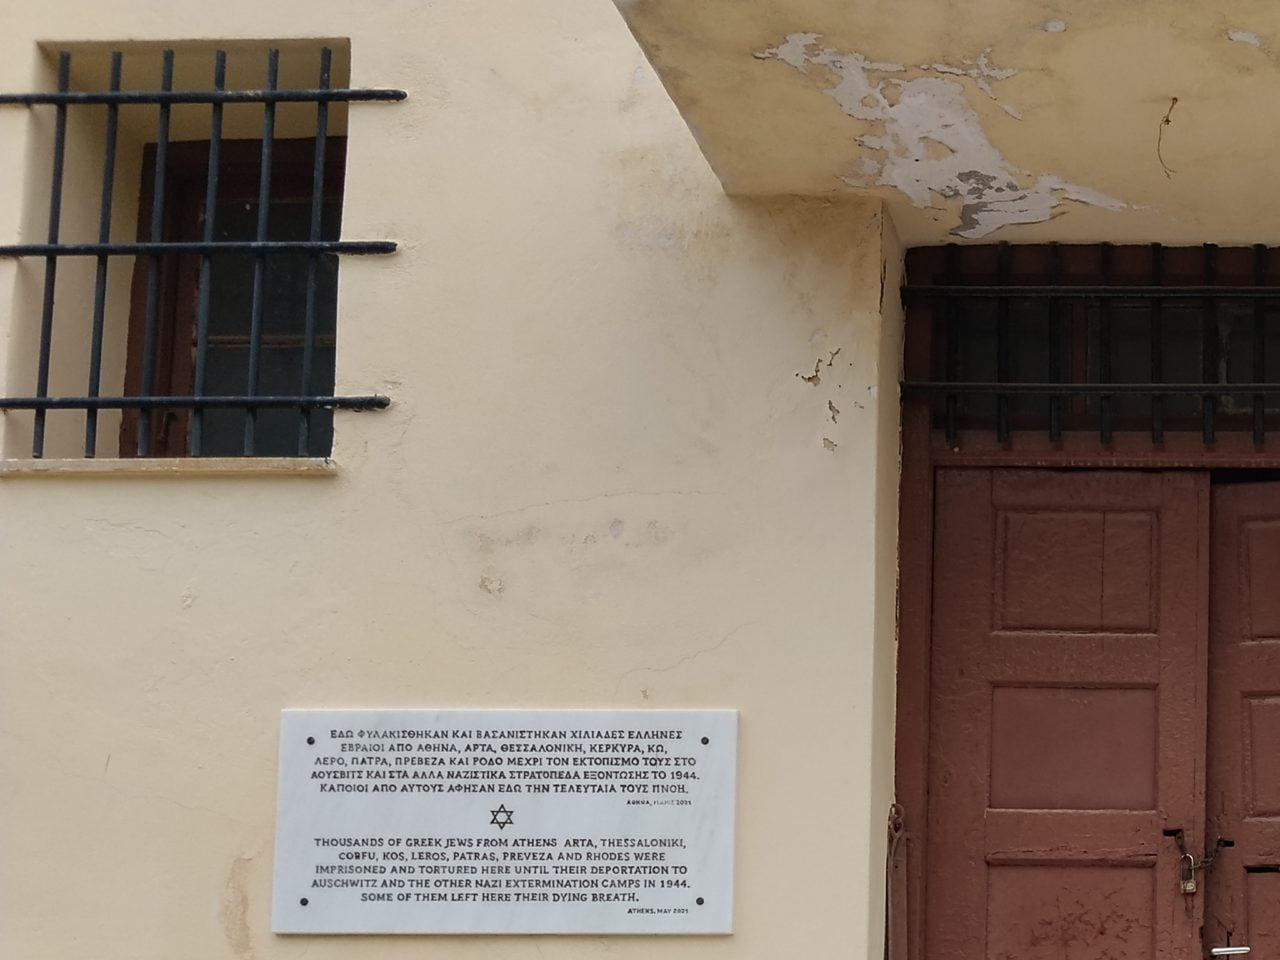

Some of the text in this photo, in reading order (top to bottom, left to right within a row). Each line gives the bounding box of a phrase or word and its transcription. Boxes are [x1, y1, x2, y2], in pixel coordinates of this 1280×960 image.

[330, 730, 683, 739] ΕΔΩ ΦΥΛΑΚΙΣΘΗΚΑΝ ΚΑΙ ΒΑΣΑΝΙΣΤΗΚΑΝ ΧΙΛΙΑΔΕΣ ΕΛΛΗΝΕΣ
[340, 743, 385, 752] ΕΒΡΑΙΟΙ
[416, 744, 461, 753] ΑΘΗΝΑ,
[464, 744, 497, 753] ΑΡΤΑ,
[501, 744, 586, 754] ΘΕΣΣΑΛΟΝΙΚΗ,
[589, 744, 645, 754] ΚΕΡΚΥΡΑ,
[647, 744, 668, 754] ΚΩ,
[314, 757, 697, 767] ΛΕΡΟ, ΠΑΤΡΑ, ΠΡΕΒΕΖΑ ΚΑΙ ΡΟΔΟ ΜΕΧΡΙ ΤΟΝ ΕΚΤΟΠΙΣΜΟ ΤΟΥΣ ΣΤΟ
[310, 770, 701, 780] ΑΟΥΣΒΙΤΣ ΚΑΙ ΣΤΑ ΑΛΛΑ ΝΑΖΙΣΤΙΚΑ ΣΤΡΑΤΟΠΕΔΑ ΕΞΟΝΤΩΣΗΣ ΤΟ 1944.
[320, 784, 689, 793] ΚΑΠΟΙΟΙ ΑΠΟ ΑΥΤΟΥΣ ΑΦΗΣΑΝ ΕΔΩ ΤΗΝ ΤΕΛΕΥΤΑΙΑ ΤΟΥΣ ΠΝΟΗ.
[314, 838, 686, 849] THOUSANDS OF GREEK JEWS FROM ATHENS ARTA, THESSALONIKI,
[338, 852, 666, 862] CORFU, KOS, LEROS, PATRAS, PREVEZA AND RHODES WERE
[315, 865, 386, 874] IMPRISONED
[418, 866, 478, 874] TORTURED
[481, 866, 512, 874] HERE
[514, 866, 550, 874] UNTIL
[552, 866, 587, 874] THEIR
[590, 866, 669, 874] DEPORTATION
[671, 866, 688, 874] TO
[311, 879, 691, 888] AUSCHWITZ AND THE OTHER NAZI EXTERMINATION CAMPS IN 1944.
[360, 893, 639, 902] SOME OF THEM LEFT HERE THEIR DYING BREATH.
